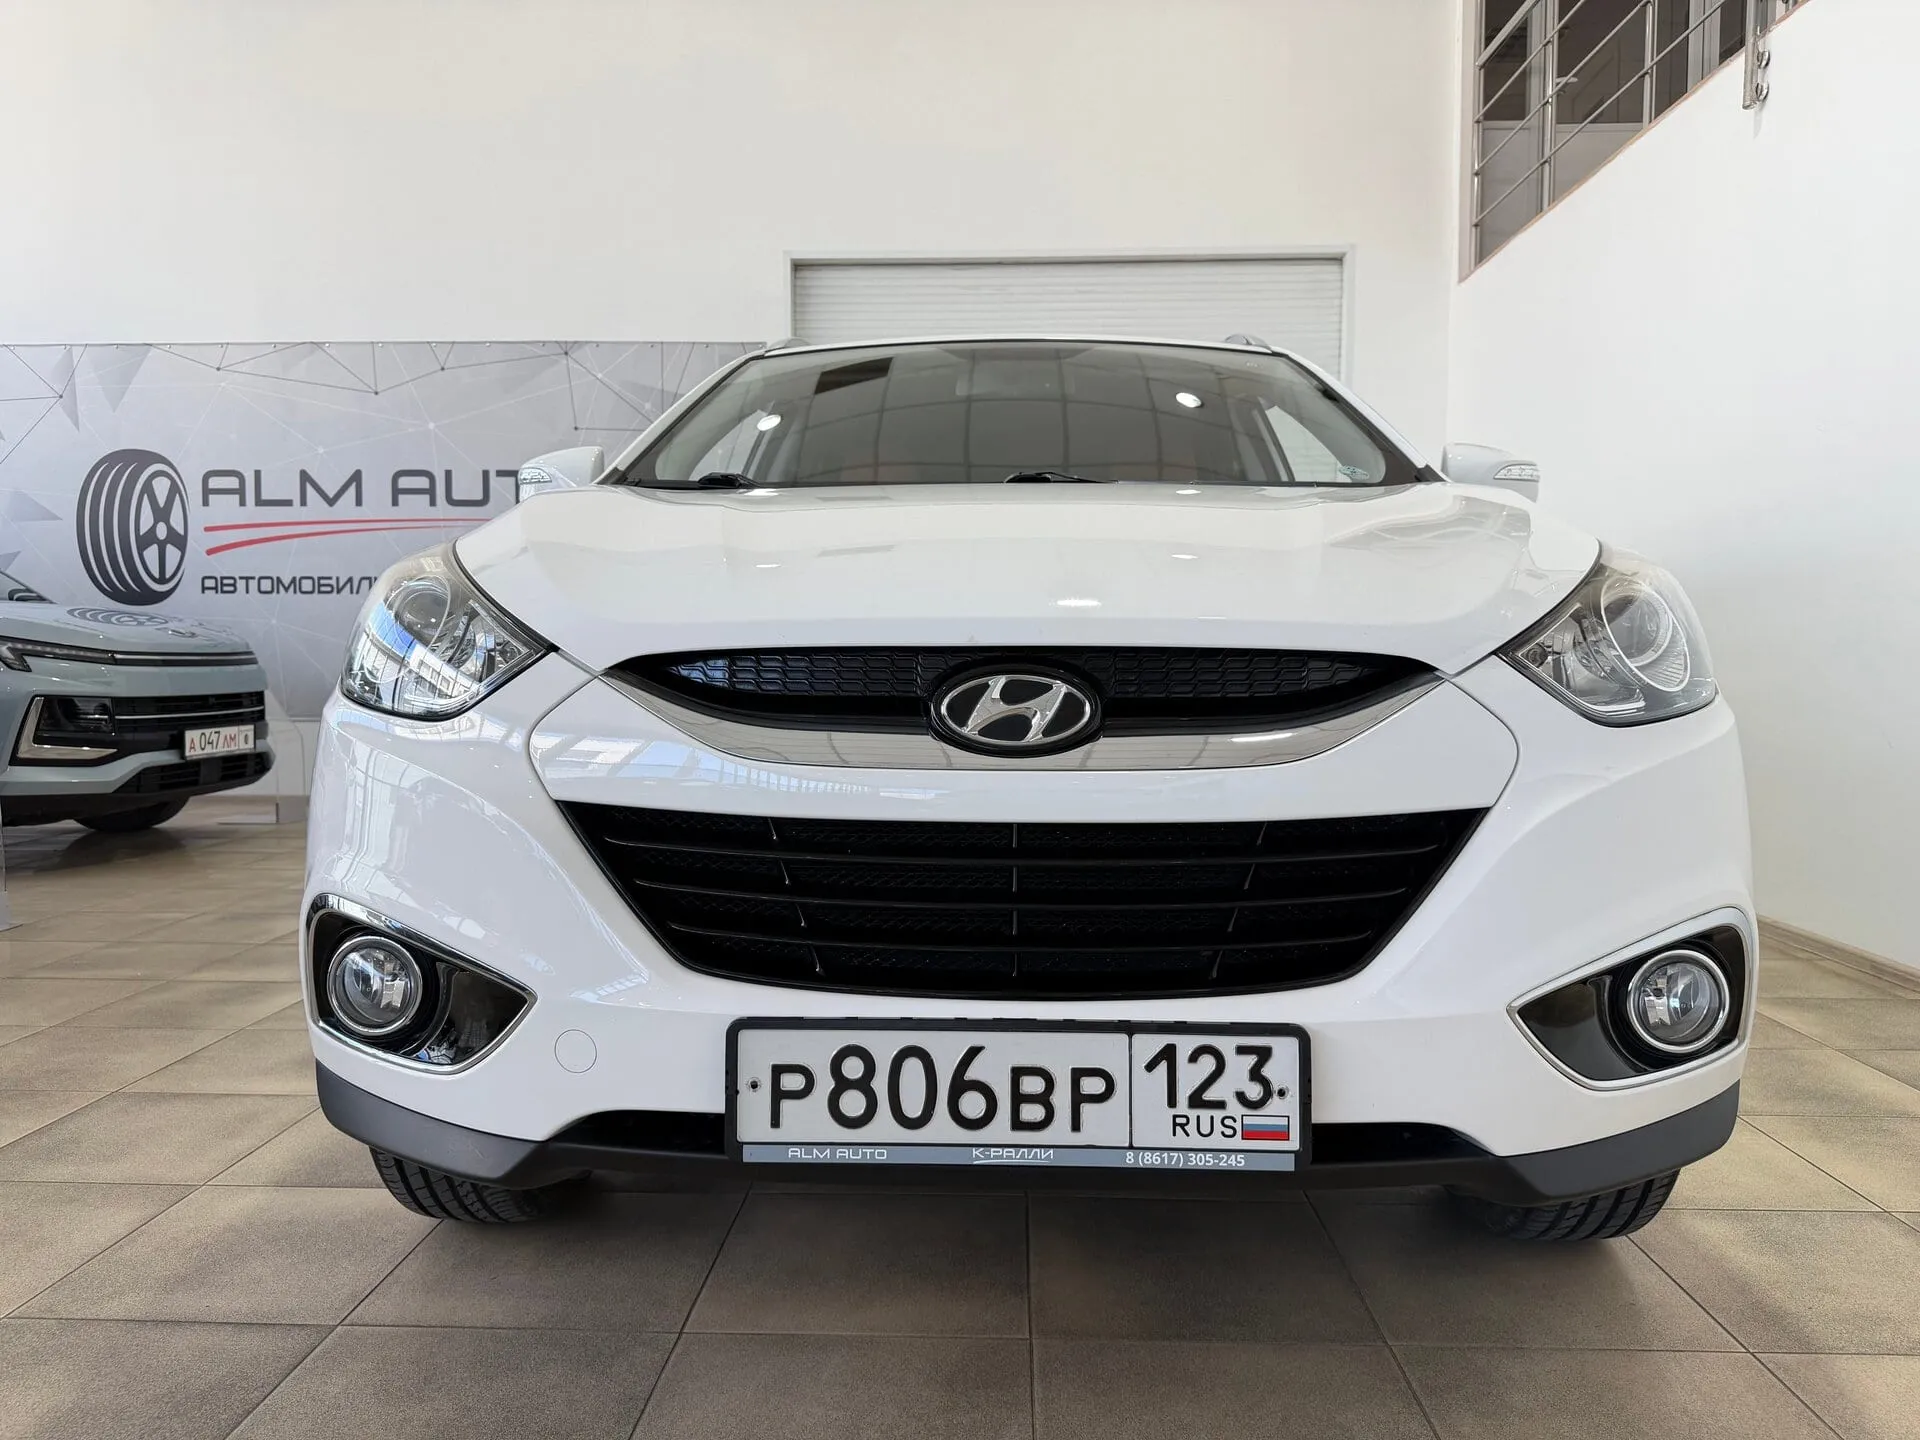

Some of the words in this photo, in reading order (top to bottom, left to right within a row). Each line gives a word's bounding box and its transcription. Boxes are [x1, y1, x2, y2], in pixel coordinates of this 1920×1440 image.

[201, 469, 363, 507] ALM
[201, 576, 378, 595] АВТОМОБИЛ
[1143, 1042, 1274, 1111] 123
[1171, 1113, 1238, 1139] RUS
[788, 1147, 831, 1160] ALM
[836, 1148, 888, 1161] AUTO
[972, 1147, 1055, 1160] К-РАЛЛИ
[1125, 1151, 1135, 1165] 8
[1138, 1151, 1185, 1168] (8617)
[1187, 1152, 1246, 1168] 305-245
